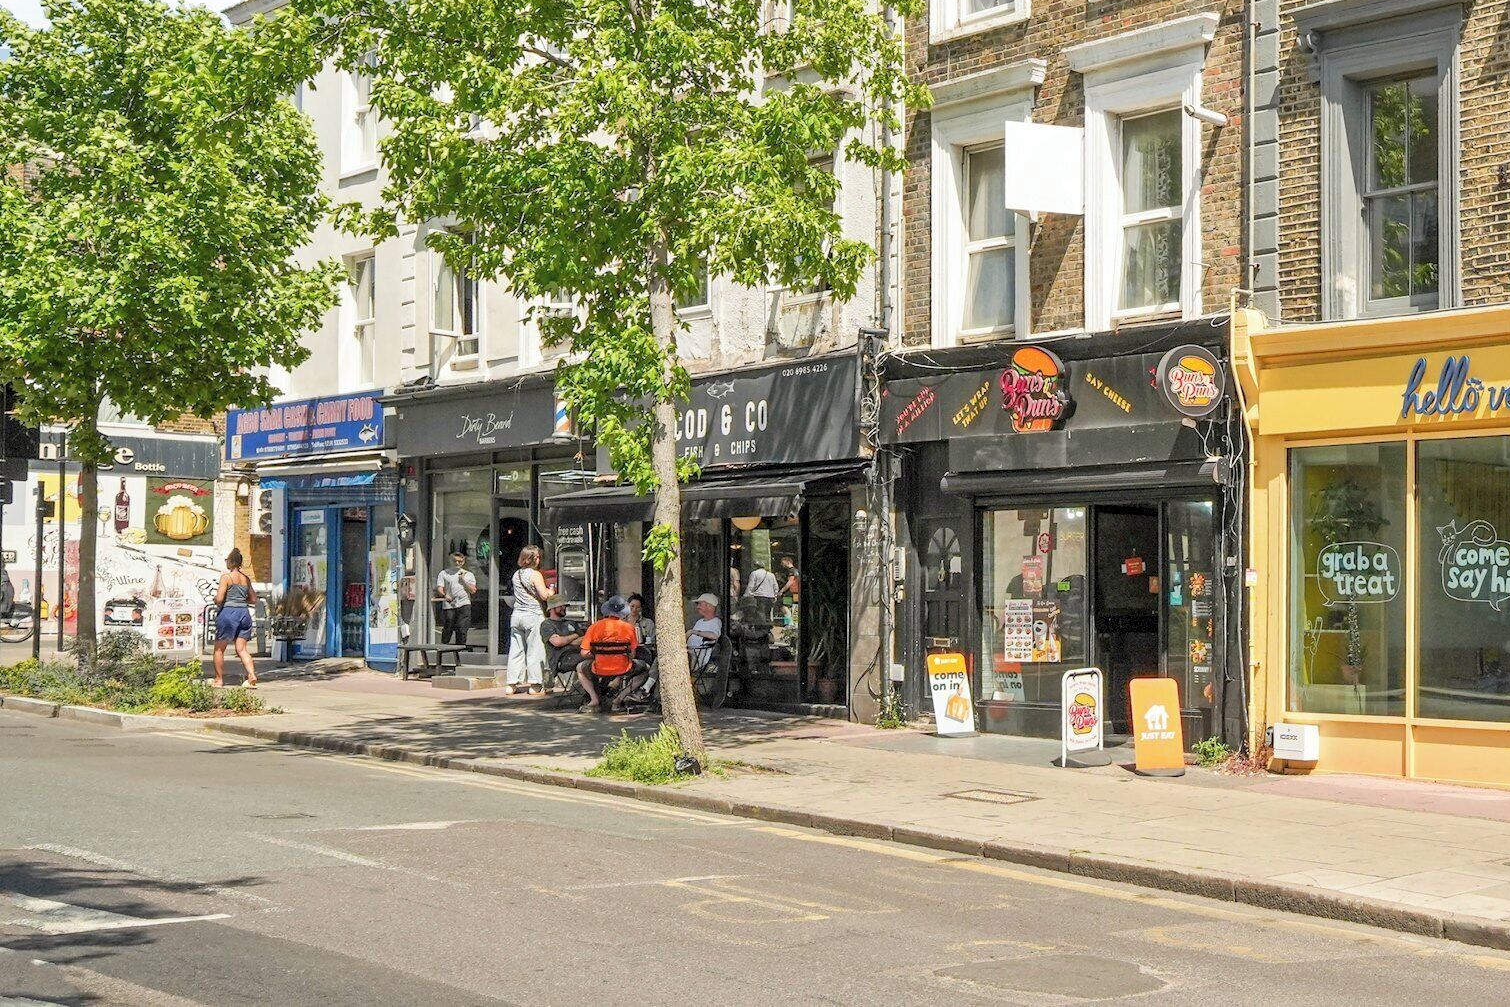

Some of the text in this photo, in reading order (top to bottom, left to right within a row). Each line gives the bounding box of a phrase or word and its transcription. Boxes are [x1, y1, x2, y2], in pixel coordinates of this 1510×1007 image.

[782, 363, 828, 377] 020 8985 4226
[952, 381, 990, 425] LET'S WRAP
[1085, 373, 1131, 413] SAY CHEESE
[347, 396, 374, 421] FOOD
[674, 399, 768, 441] COD & CO
[961, 396, 989, 428] THAT UP
[456, 411, 513, 442] Dirty Beard
[684, 440, 756, 458] FISH & CHIPS
[134, 462, 166, 472] Bottle
[1322, 545, 1388, 578] grab a
[1455, 546, 1510, 567] come
[1333, 571, 1395, 595] treat
[1447, 566, 1488, 598] say
[932, 680, 960, 691] on in
[934, 670, 964, 681] come
[1141, 732, 1176, 741] JUST EAT
